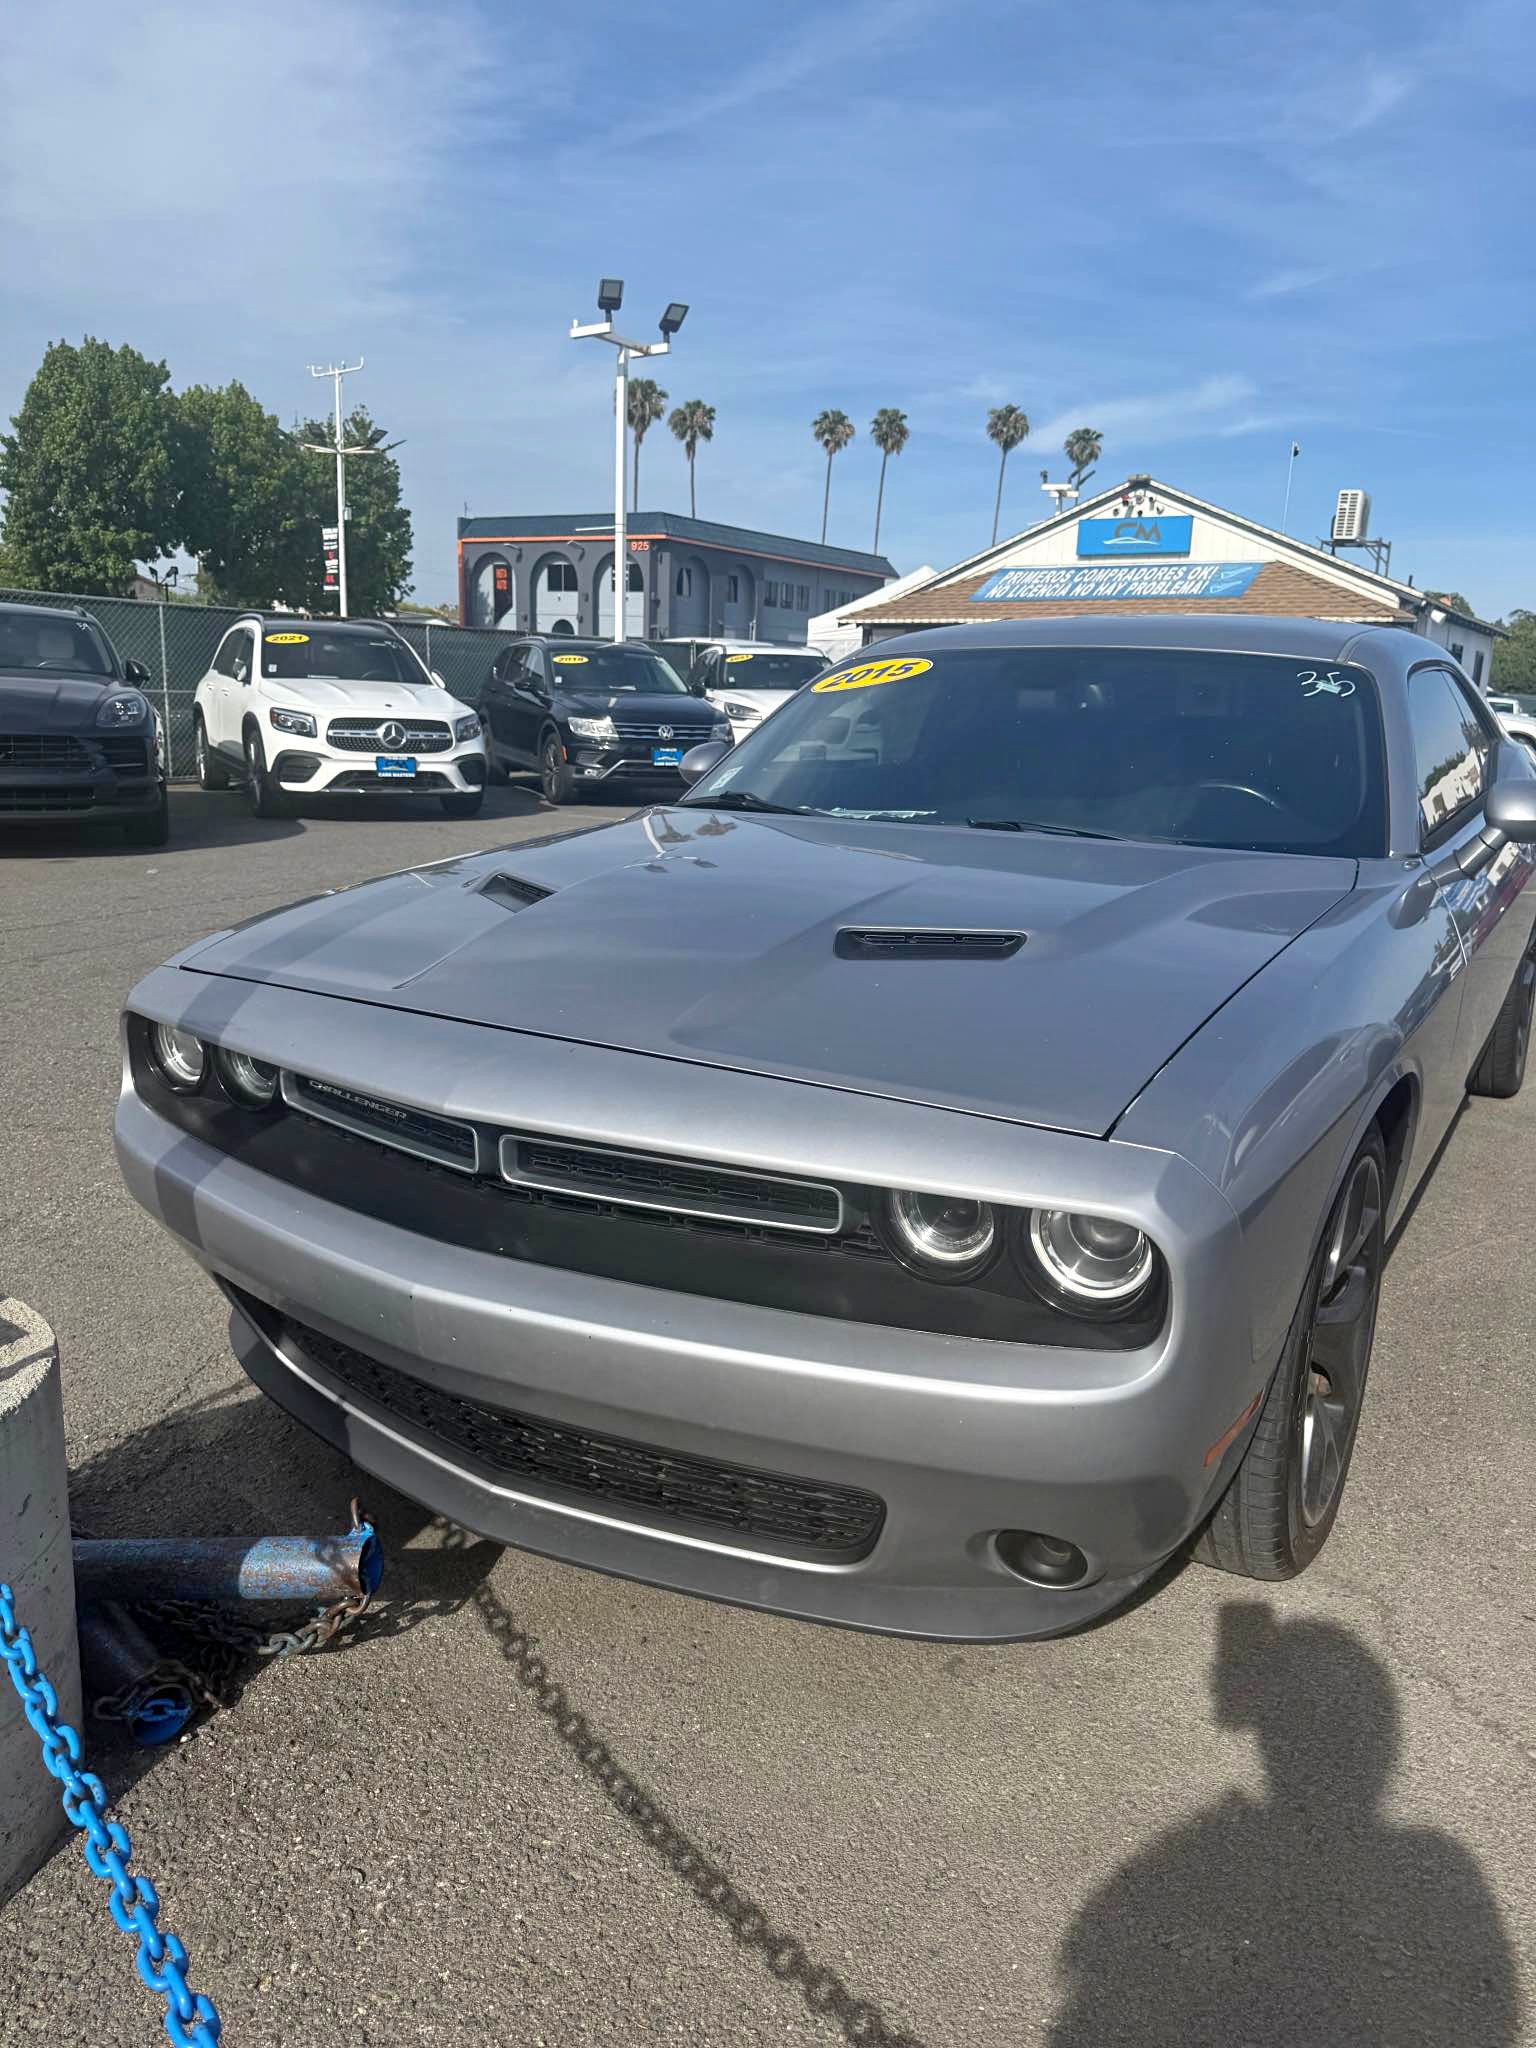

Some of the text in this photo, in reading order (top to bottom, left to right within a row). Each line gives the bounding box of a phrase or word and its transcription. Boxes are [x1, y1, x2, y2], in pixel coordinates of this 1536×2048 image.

[1114, 521, 1161, 542] CM
[631, 541, 649, 551] 925
[1001, 565, 1220, 584] PRIMEROS COMPRADORES OK!
[987, 580, 1210, 598] NO LICENCIA NO HAY PROBLEMA!
[819, 661, 922, 690] 2015
[1297, 671, 1356, 697] 35
[309, 1079, 408, 1120] CHALLENGER
